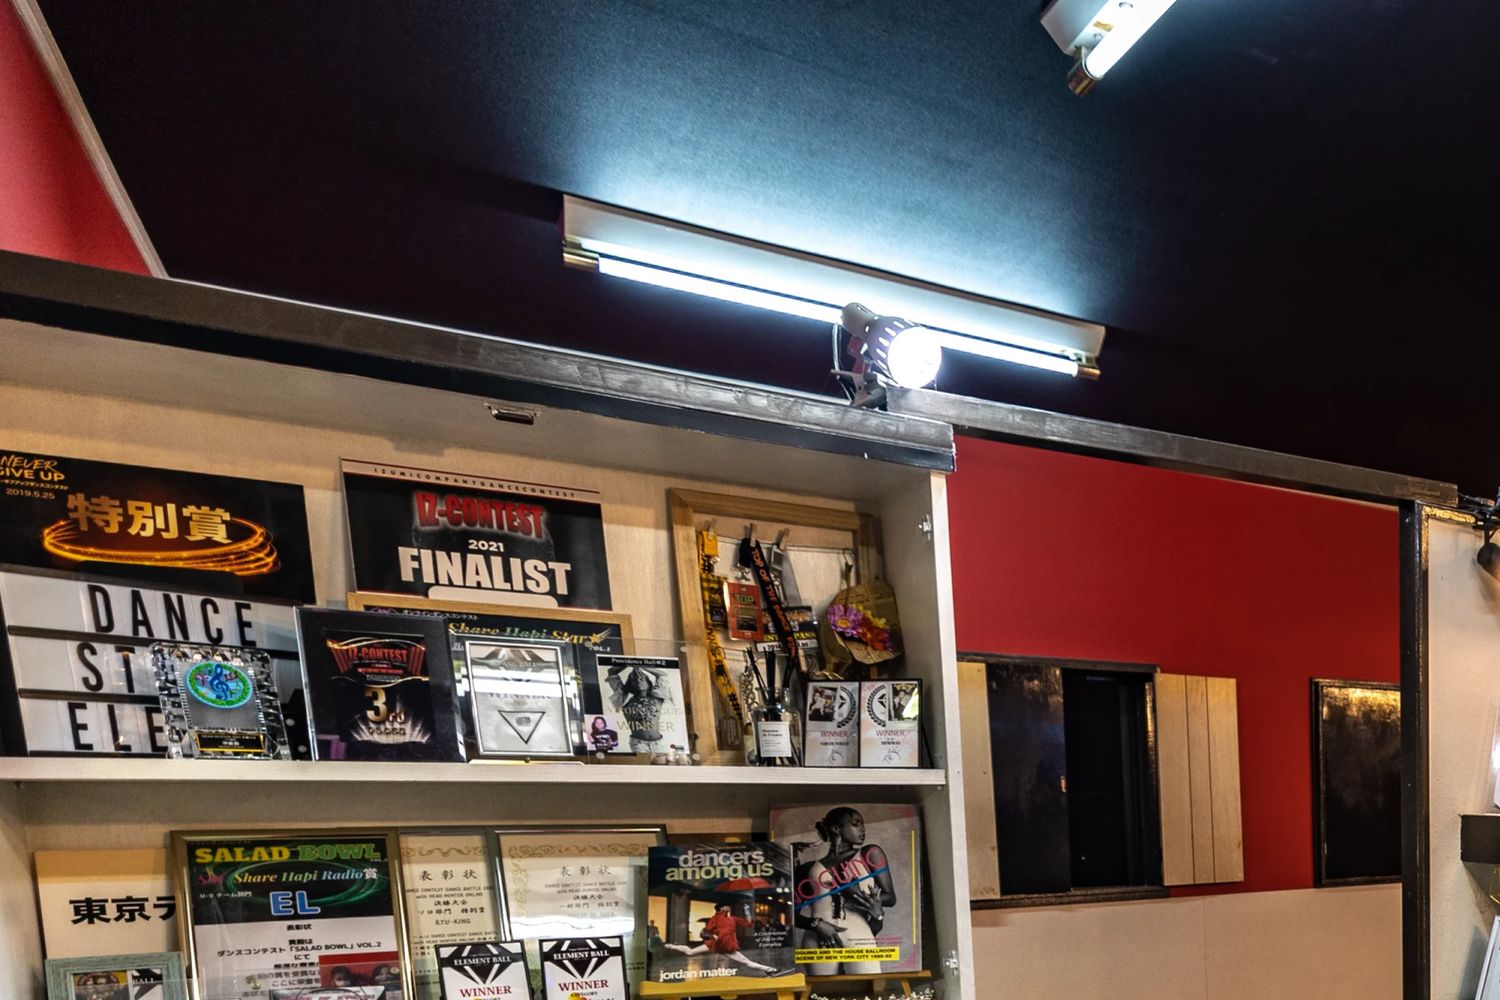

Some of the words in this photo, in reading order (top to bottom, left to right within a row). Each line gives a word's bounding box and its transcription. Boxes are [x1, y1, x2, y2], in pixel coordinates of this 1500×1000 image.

[40, 470, 65, 482] UP
[66, 493, 233, 544] 特別賞
[468, 539, 504, 552] 2021
[398, 546, 571, 595] FINALIST
[88, 584, 256, 647] DANCE
[68, 702, 167, 752] ELE
[195, 846, 290, 863] SALAD
[298, 844, 381, 860] BOWL
[679, 850, 765, 868] dancers
[234, 872, 277, 884] Share
[281, 870, 318, 883] Hapi
[420, 869, 477, 881] 表彰状
[665, 864, 743, 882] among
[747, 861, 775, 879] us
[795, 848, 887, 904] OGUING
[270, 890, 321, 916] EL
[453, 956, 489, 967] ELEMENT
[492, 955, 513, 964] BALL
[553, 951, 588, 962] ELEMENT
[589, 950, 610, 958] BALL
[659, 968, 698, 983] jordan
[699, 967, 738, 980] matter
[459, 985, 512, 998] WINNER
[558, 979, 609, 992] WINNER
